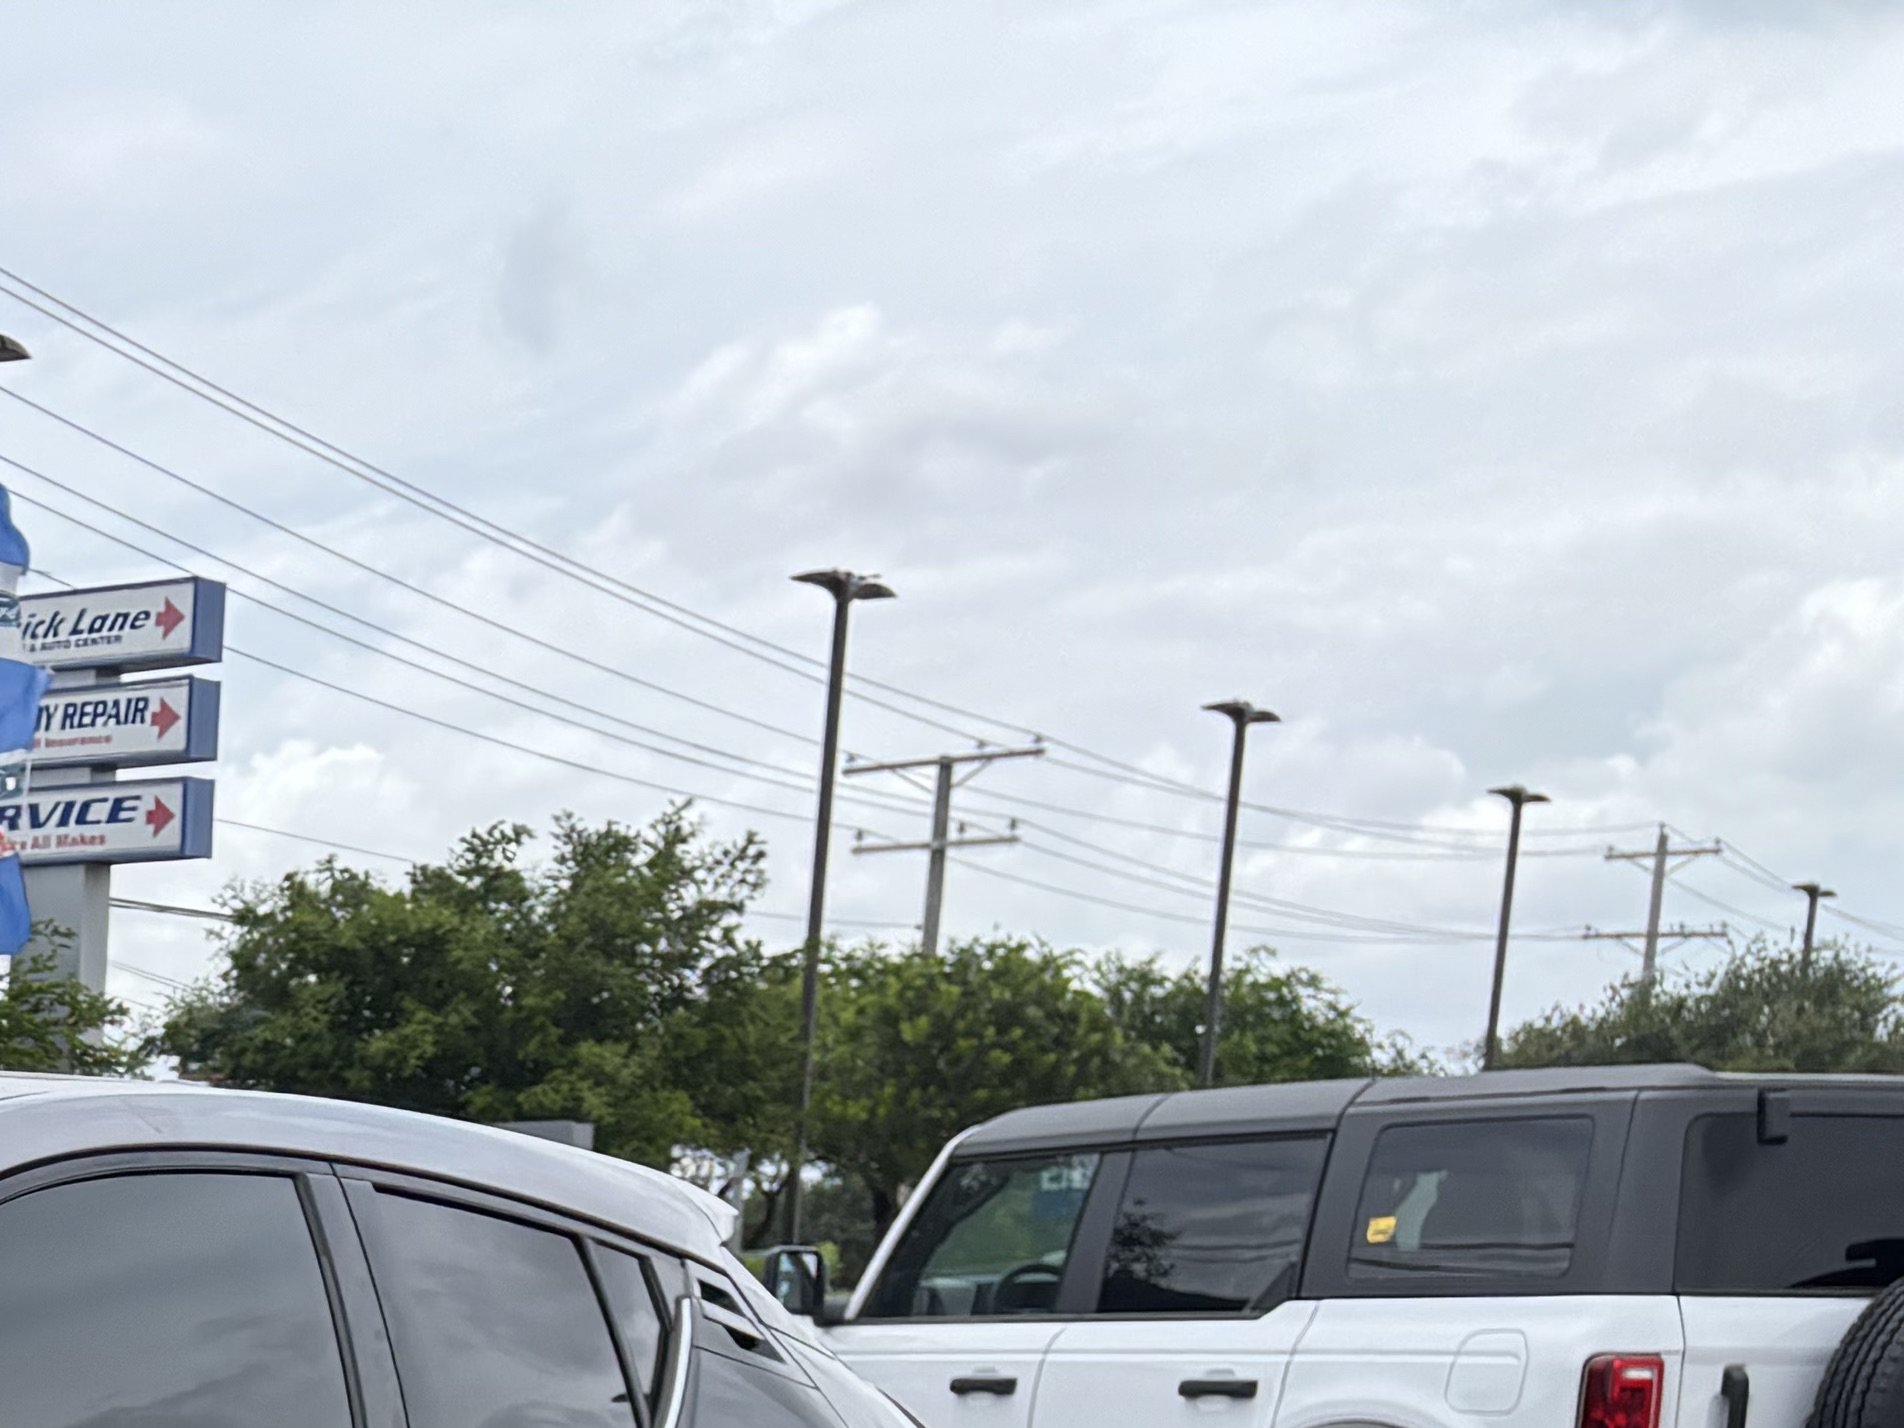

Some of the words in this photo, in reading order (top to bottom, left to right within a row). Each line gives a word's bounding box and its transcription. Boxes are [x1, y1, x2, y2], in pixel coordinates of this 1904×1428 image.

[21, 611, 64, 640] ick
[68, 608, 150, 636] Lane
[60, 697, 148, 730] REPAIR
